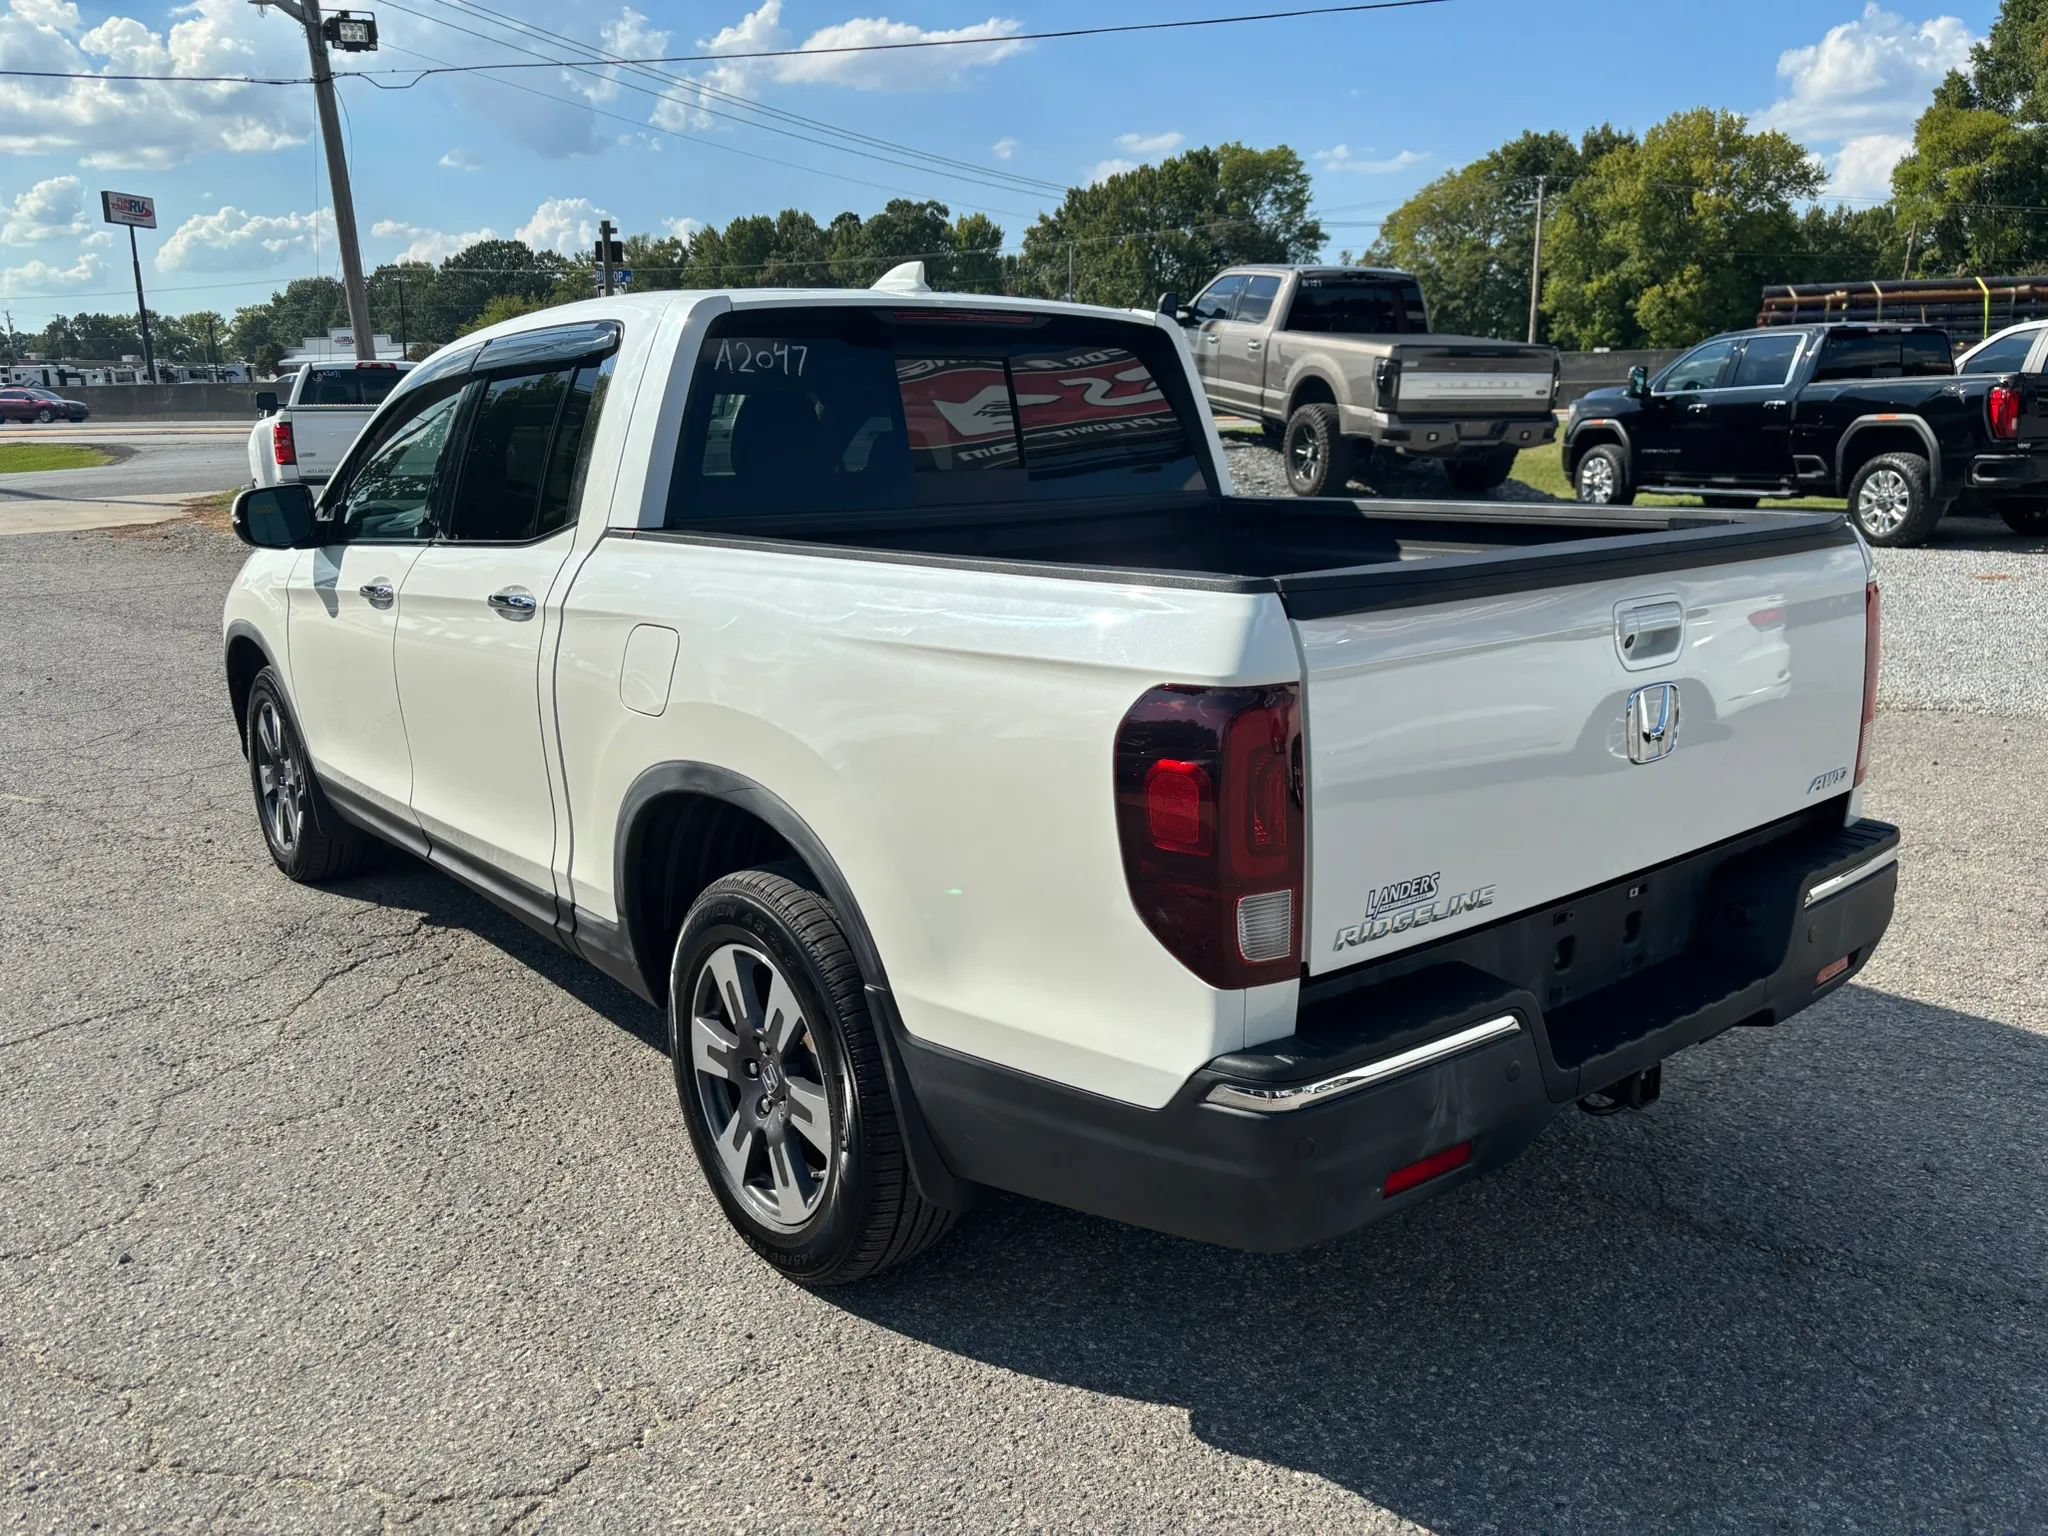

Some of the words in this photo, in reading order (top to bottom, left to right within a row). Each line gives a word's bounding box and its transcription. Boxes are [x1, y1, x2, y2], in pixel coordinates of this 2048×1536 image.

[130, 199, 146, 213] RV
[596, 271, 623, 282] BIOP
[713, 338, 808, 377] A2047
[1807, 767, 1848, 795] AWD
[1365, 871, 1441, 920] LANDERS
[1333, 884, 1497, 951] RIDGELINE
